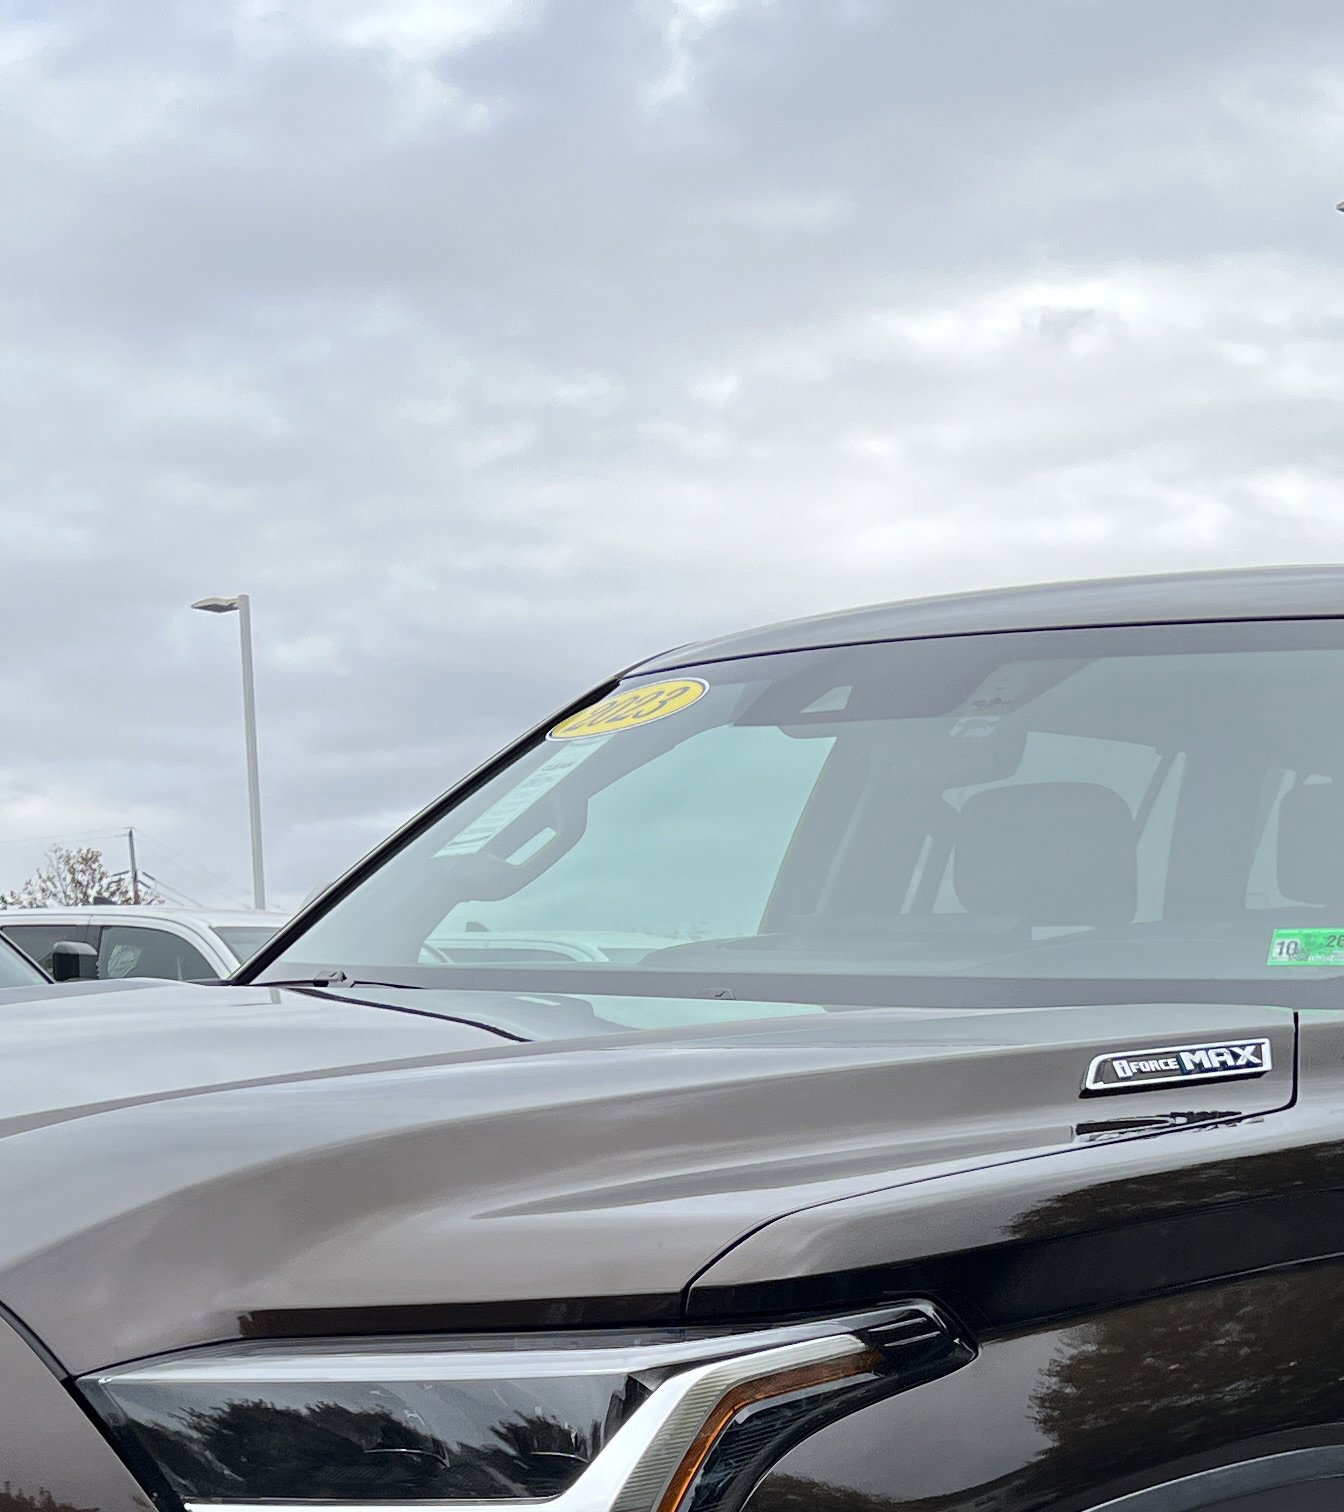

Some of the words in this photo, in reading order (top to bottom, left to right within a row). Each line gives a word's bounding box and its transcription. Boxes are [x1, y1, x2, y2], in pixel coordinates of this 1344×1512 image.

[561, 686, 691, 733] 2023
[1276, 940, 1299, 956] 10
[1179, 1045, 1262, 1074] MAX
